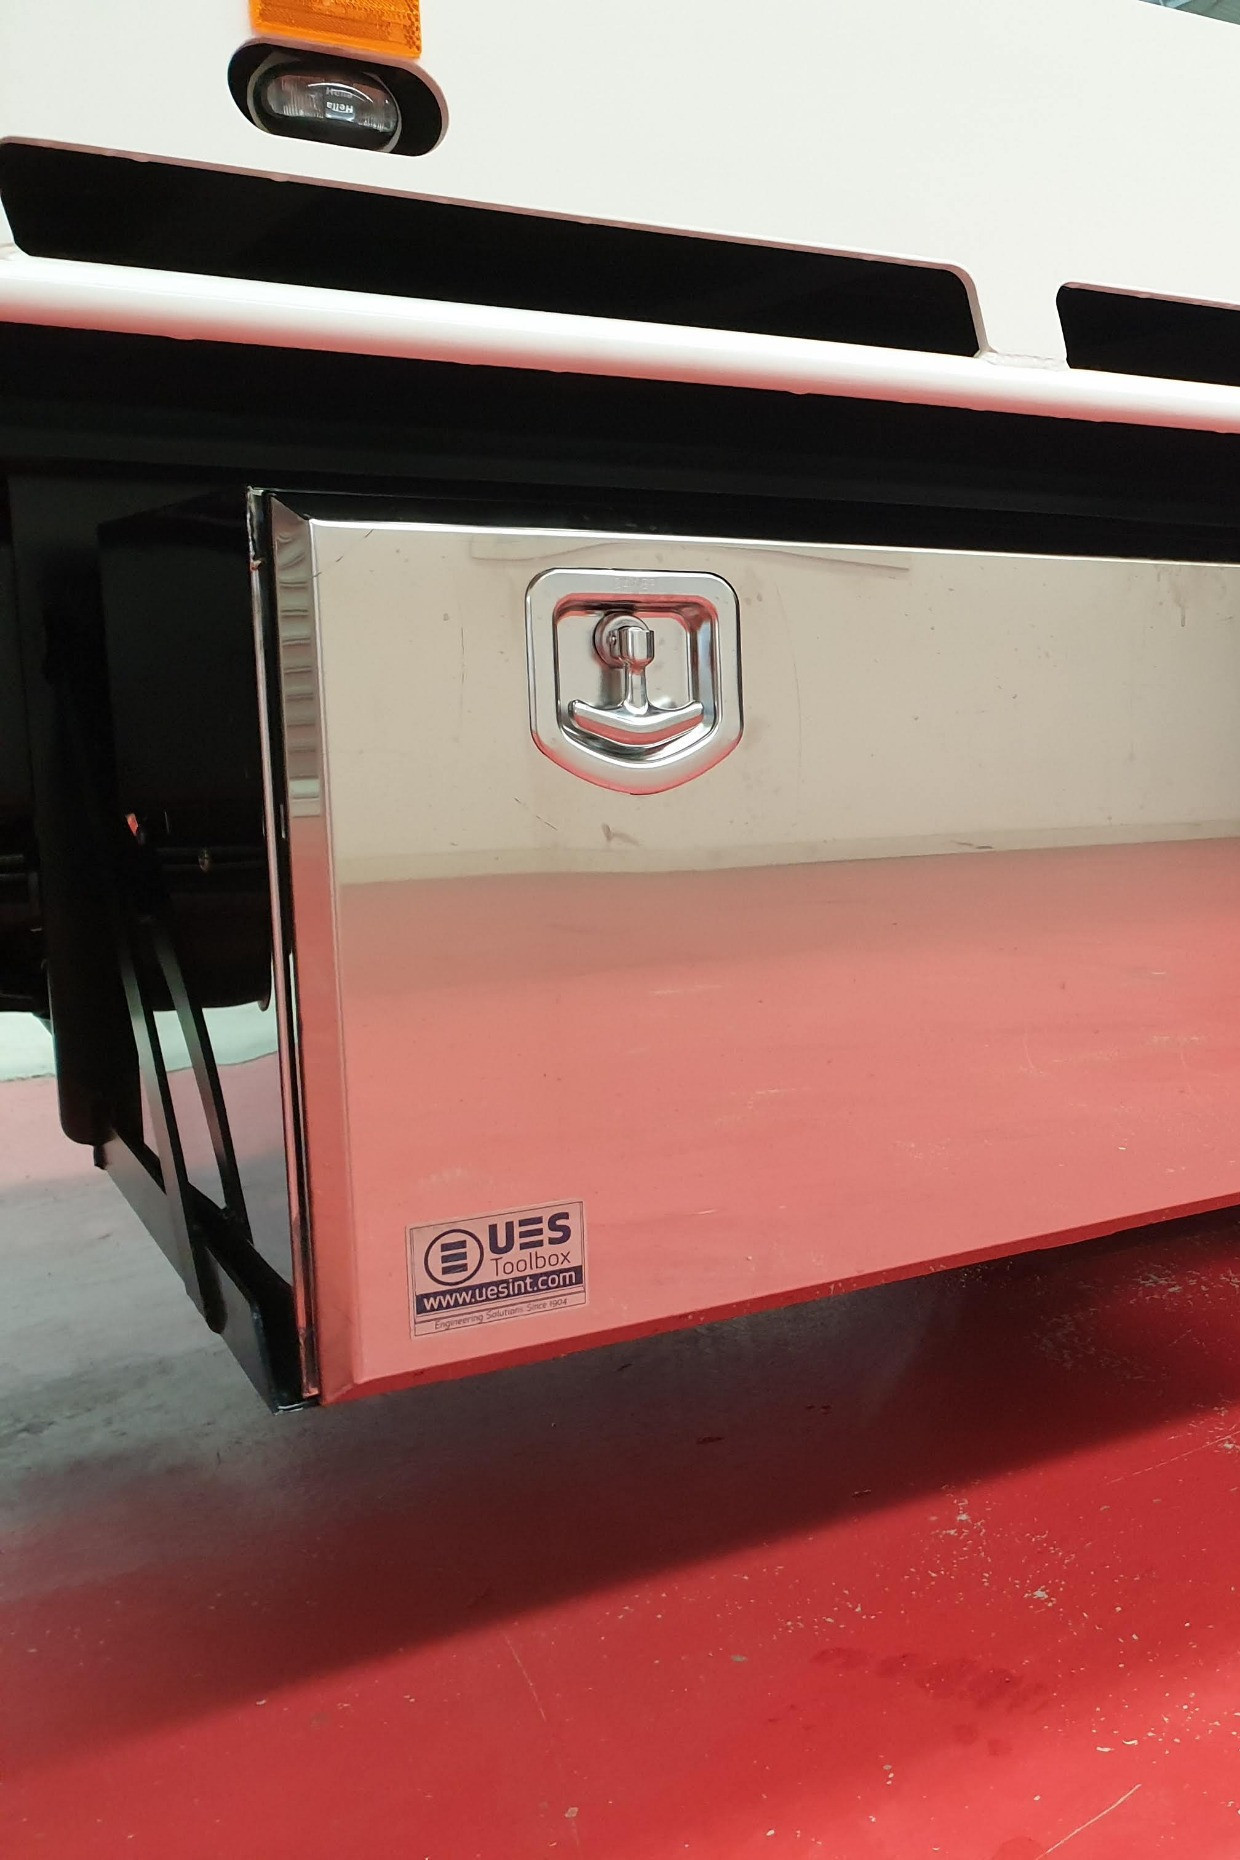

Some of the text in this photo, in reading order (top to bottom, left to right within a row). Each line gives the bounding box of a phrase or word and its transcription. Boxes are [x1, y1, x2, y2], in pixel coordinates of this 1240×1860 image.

[326, 101, 353, 113] Hella
[488, 1211, 572, 1255] UES
[490, 1251, 571, 1276] Toolbox
[423, 1270, 576, 1310] www.uesint.com
[434, 1314, 484, 1330] Engineering
[486, 1305, 524, 1320] Solutions
[526, 1301, 548, 1312] Since
